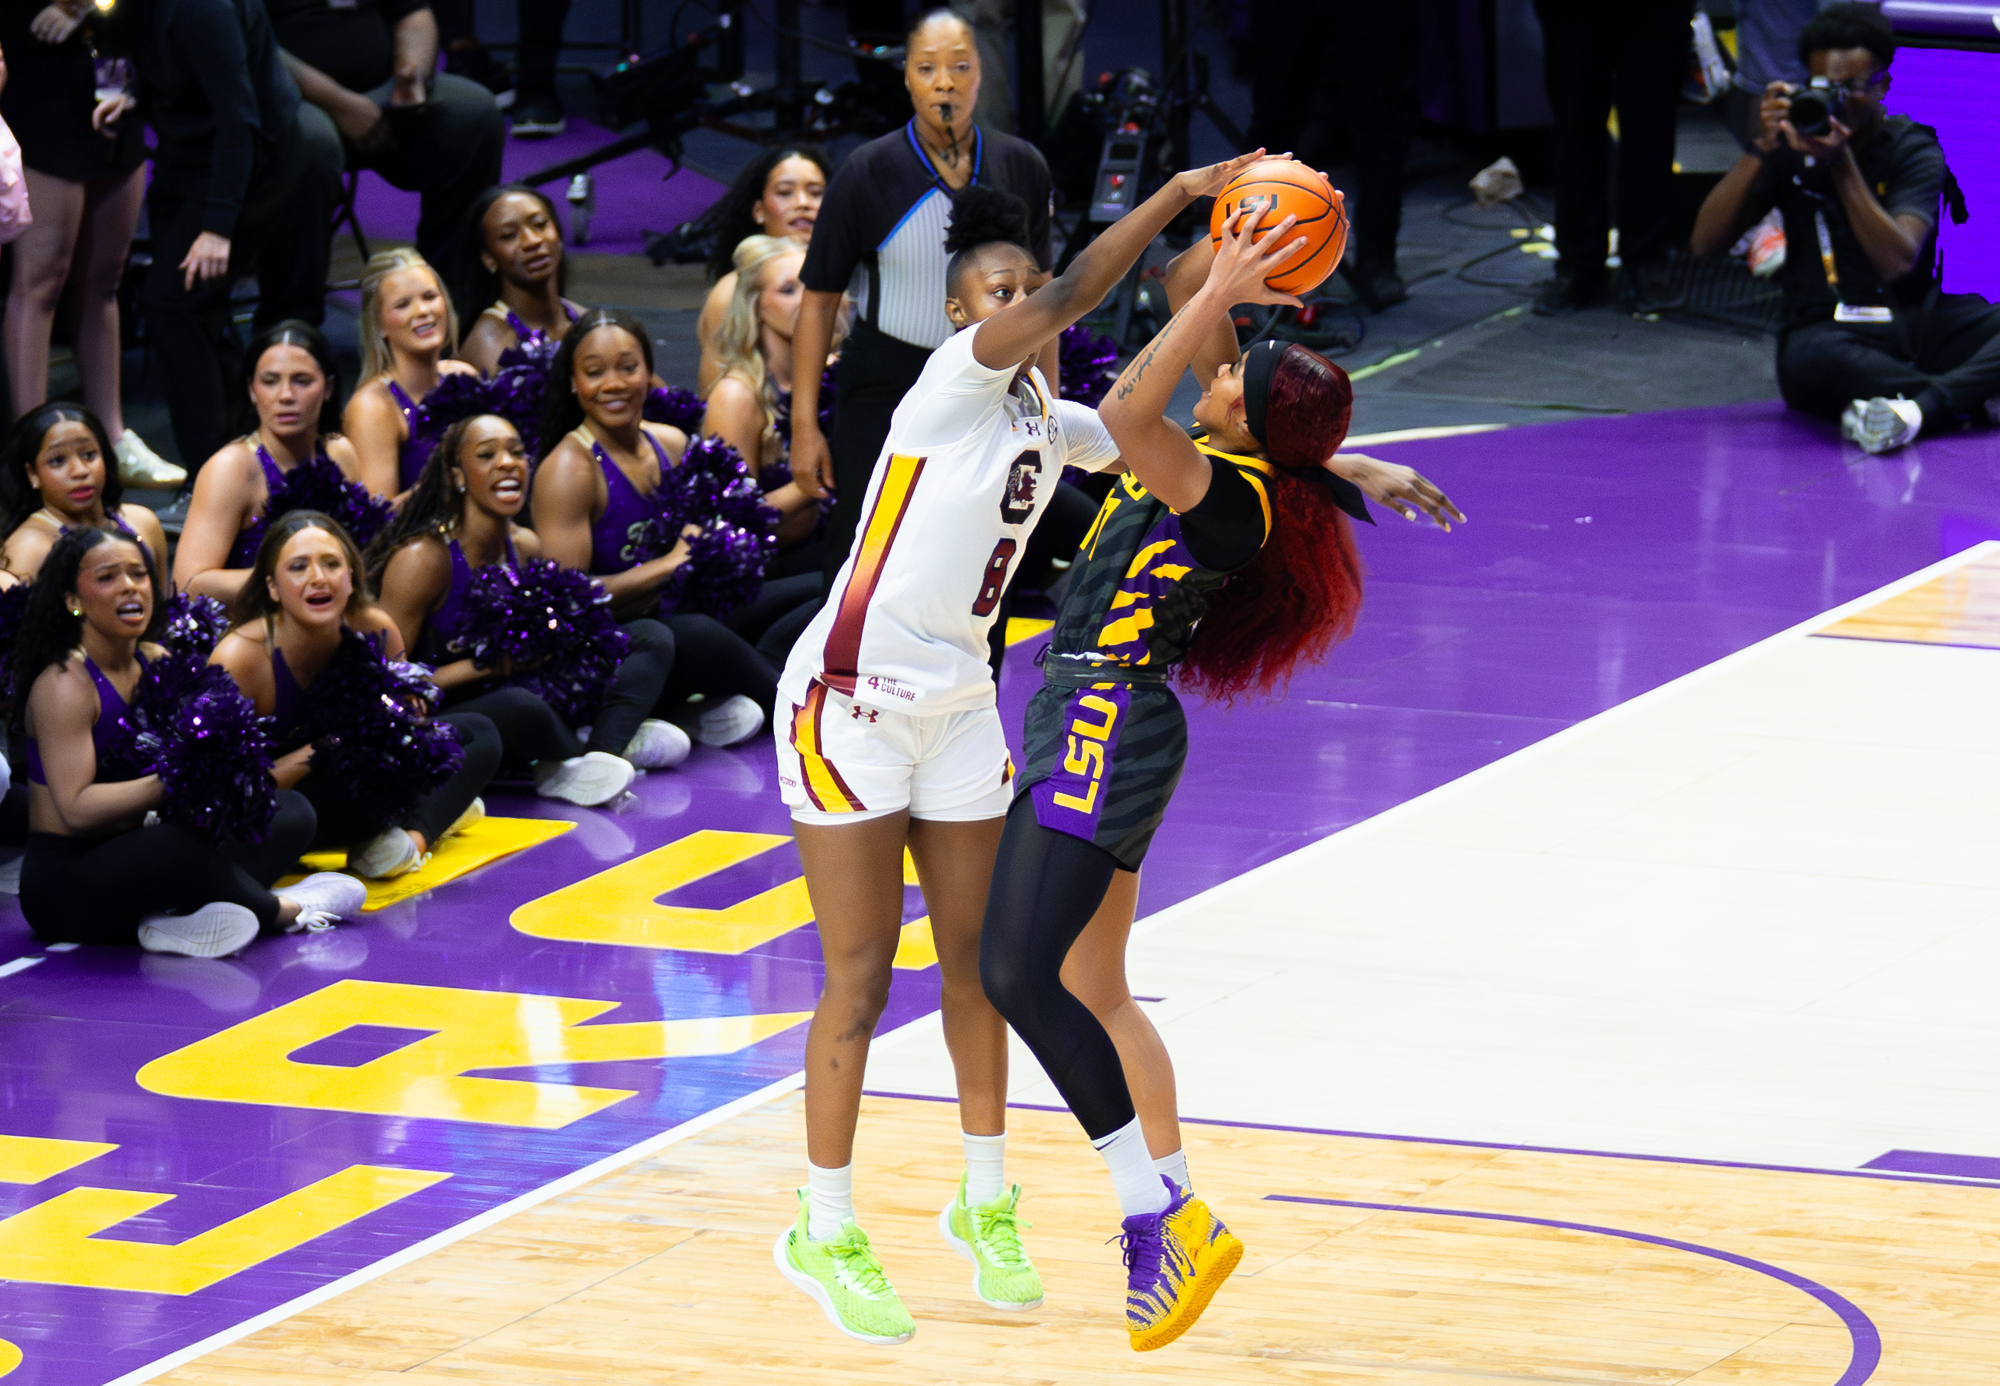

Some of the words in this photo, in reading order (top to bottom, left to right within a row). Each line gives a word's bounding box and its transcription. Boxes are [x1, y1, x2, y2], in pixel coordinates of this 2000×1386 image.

[972, 538, 1016, 617] 8
[867, 676, 880, 690] 4
[883, 677, 898, 686] THE
[880, 683, 917, 702] CULTURE
[1053, 695, 1118, 815] LSU
